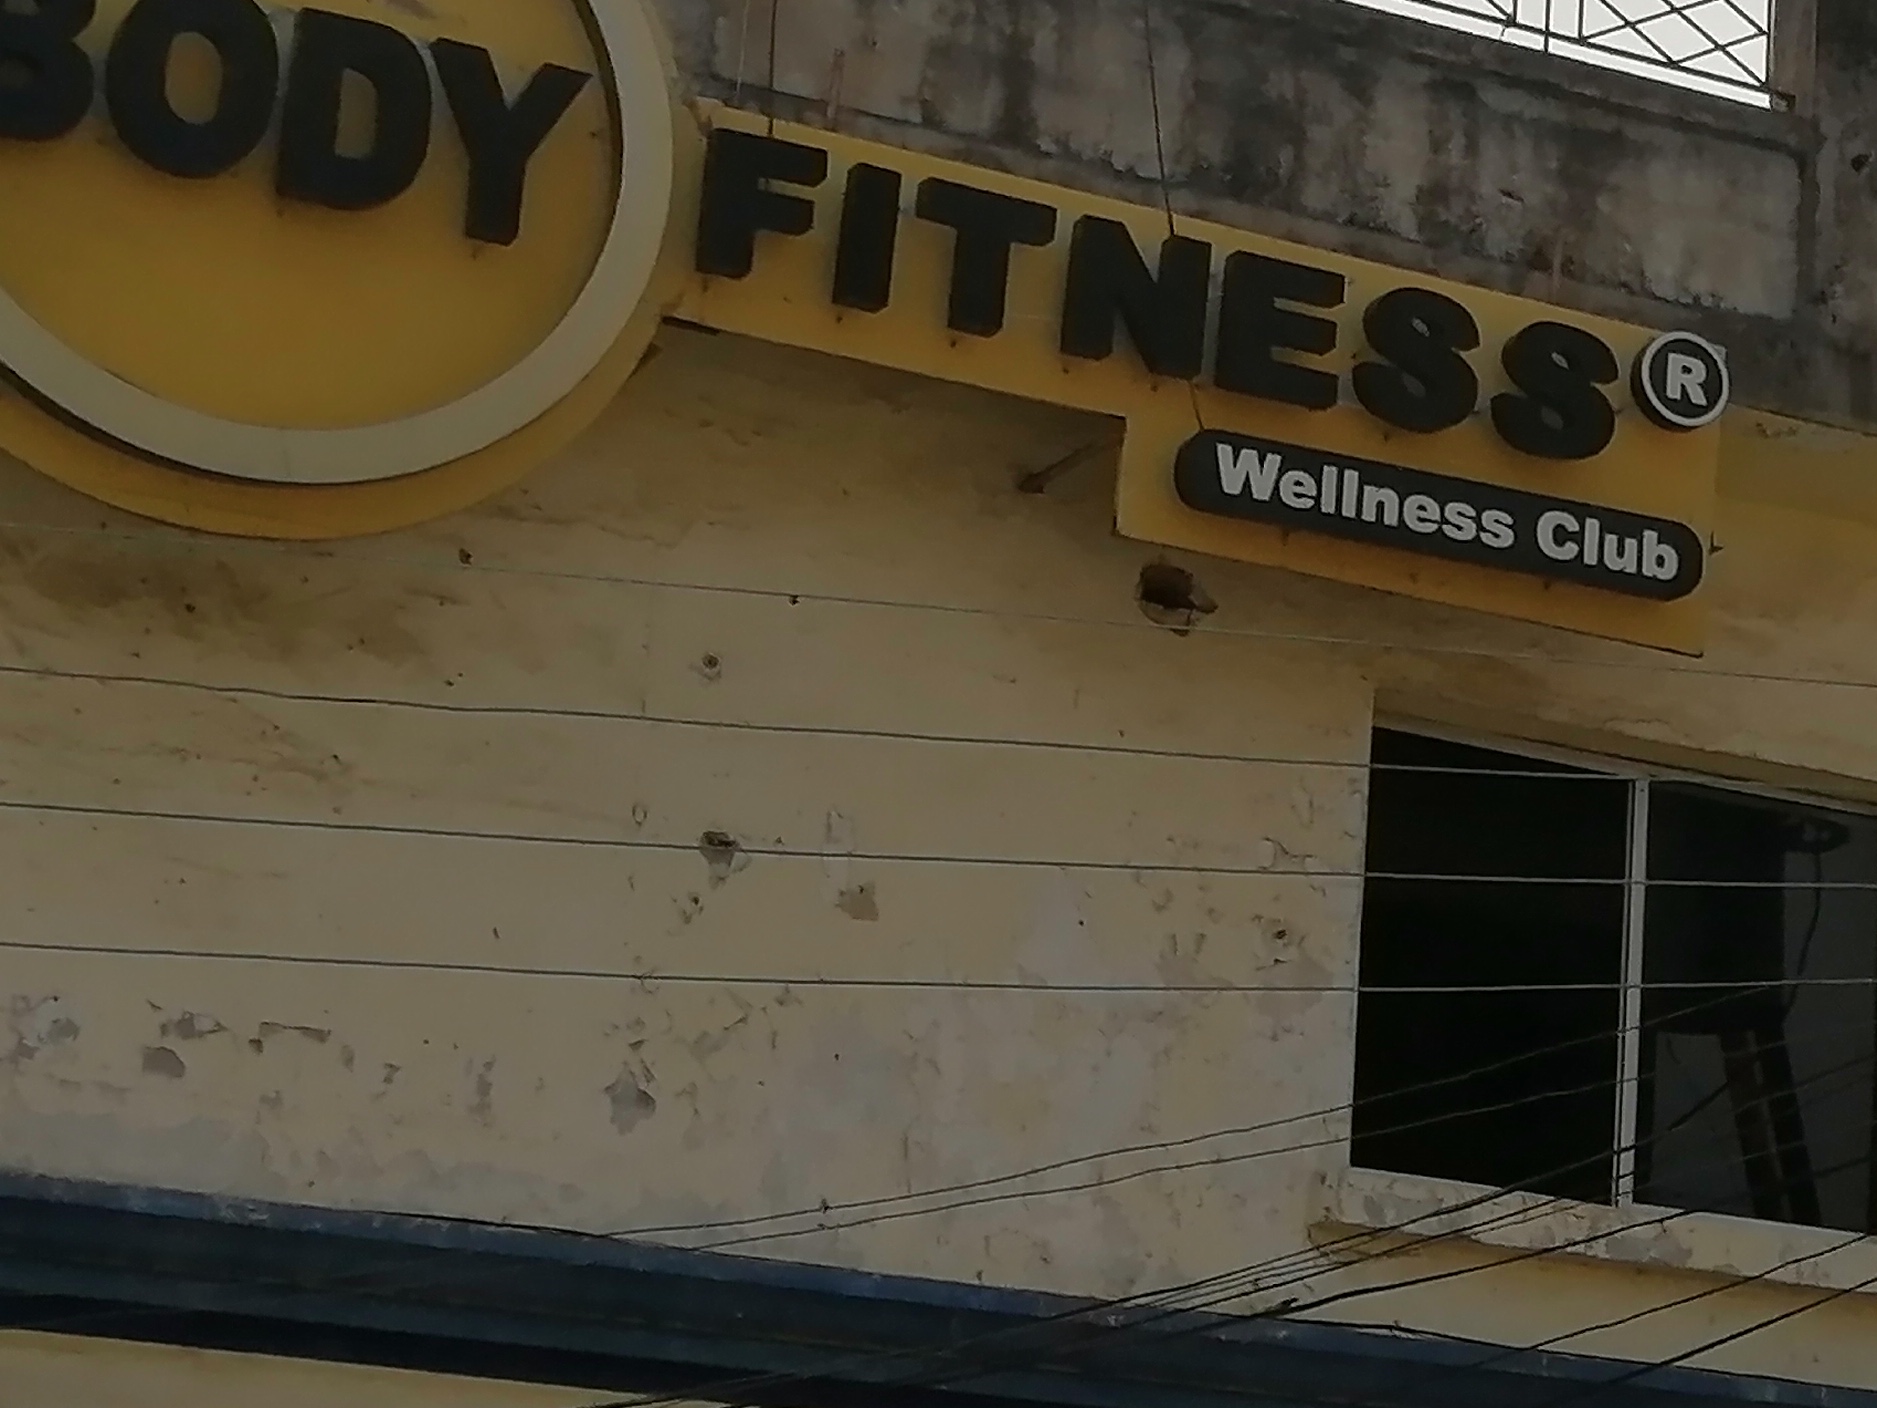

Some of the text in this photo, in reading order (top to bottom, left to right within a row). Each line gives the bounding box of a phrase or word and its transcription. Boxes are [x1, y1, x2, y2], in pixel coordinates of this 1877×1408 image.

[696, 128, 1620, 462] FITNESS
[1215, 441, 1679, 583] Wellness Club
